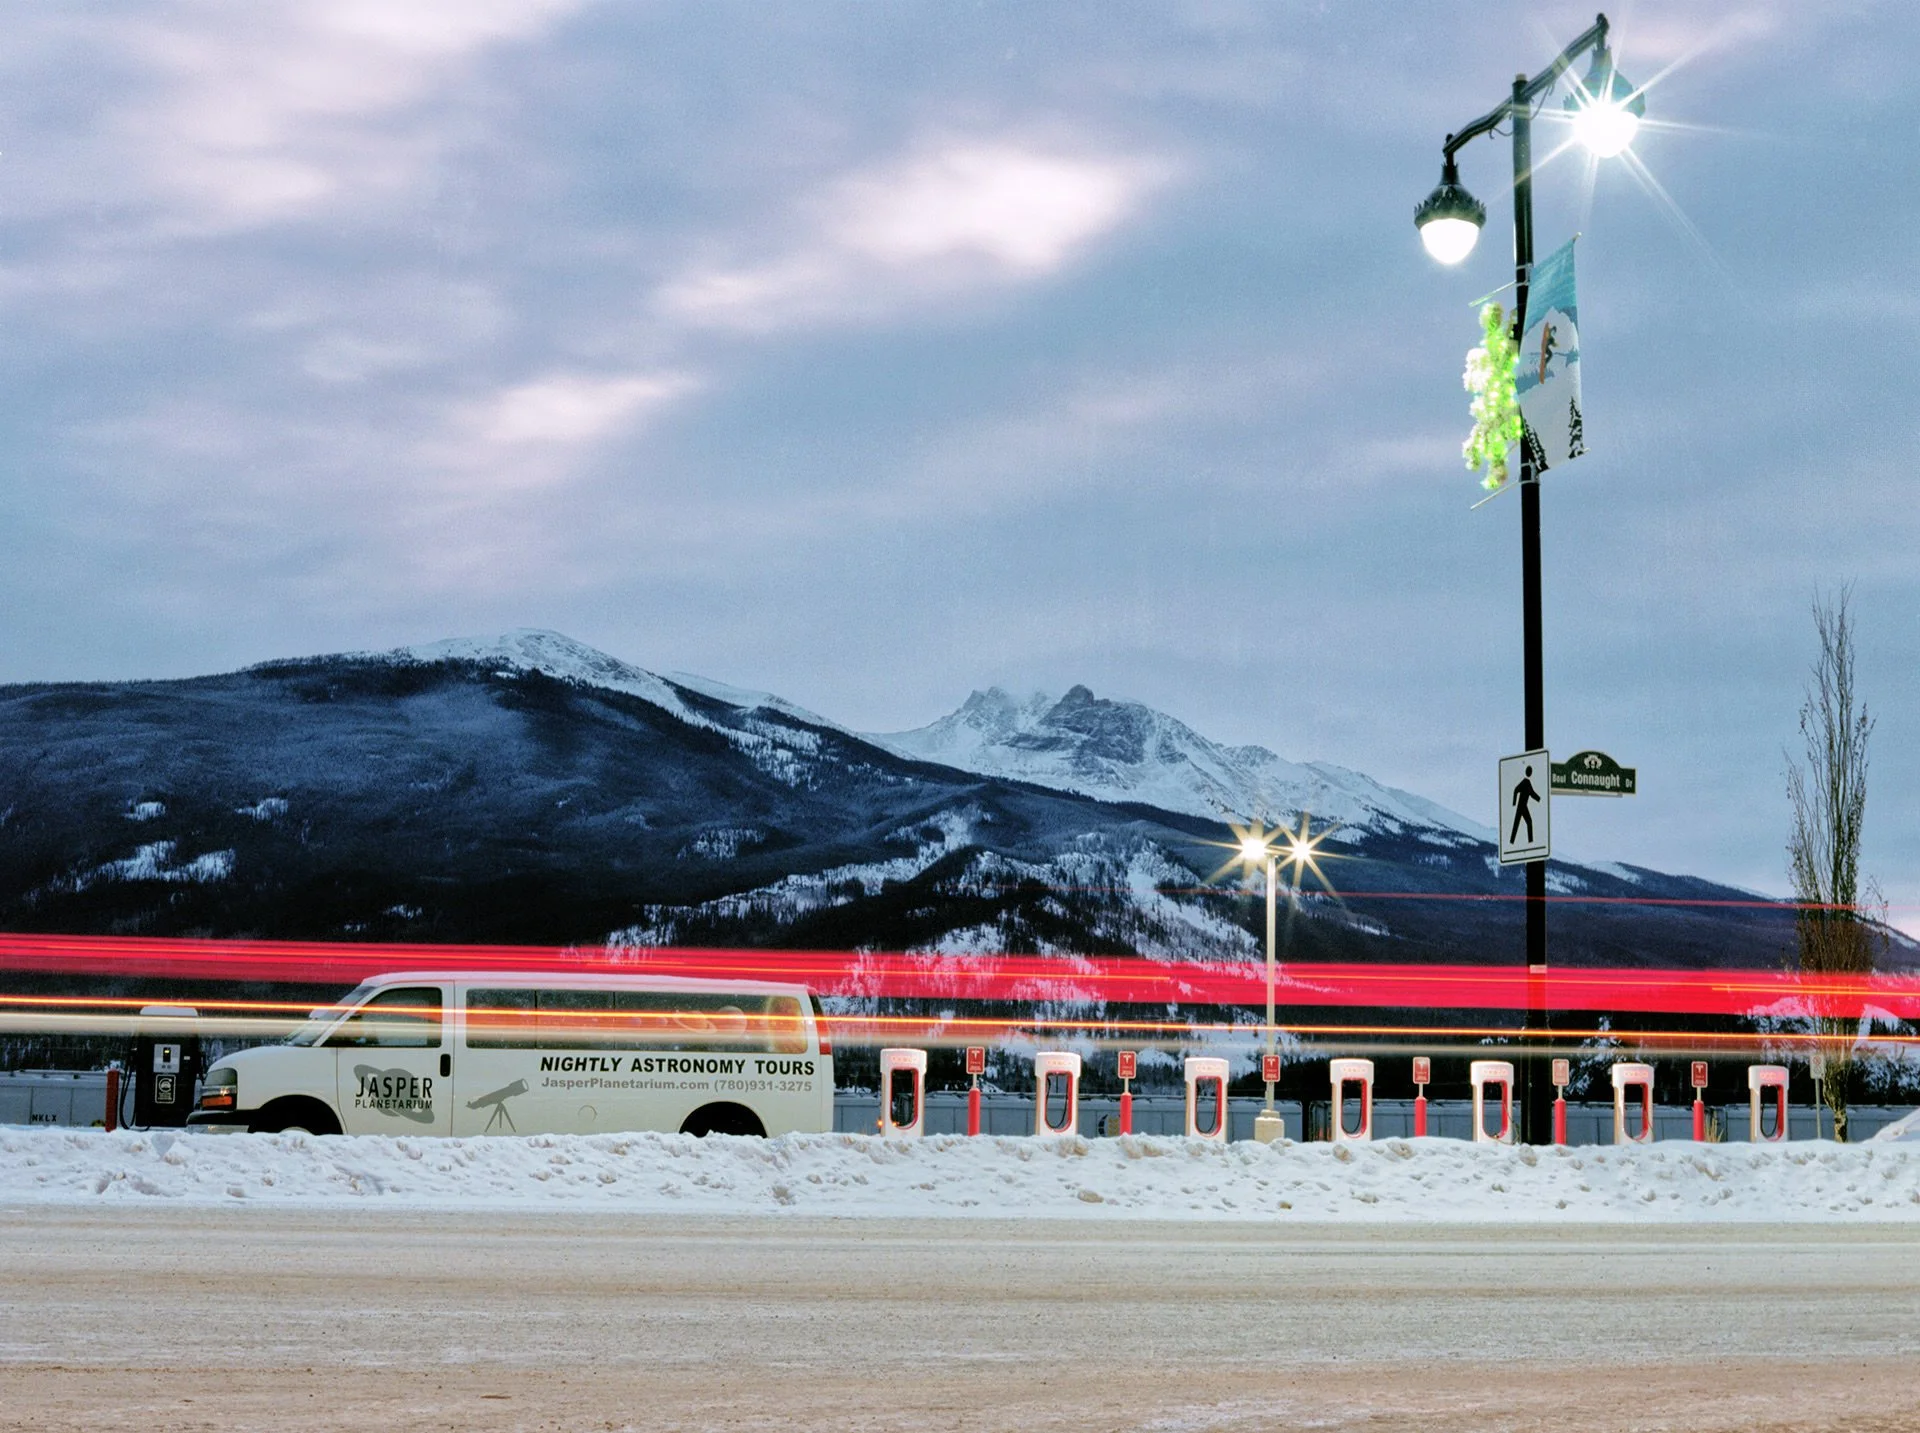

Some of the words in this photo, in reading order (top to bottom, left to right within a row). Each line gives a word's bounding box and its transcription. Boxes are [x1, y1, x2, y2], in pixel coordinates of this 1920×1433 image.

[1571, 771, 1620, 789] Connaught
[1625, 779, 1632, 788] Dr
[540, 1056, 623, 1072] NIGHTLY
[631, 1058, 746, 1074] ASTRONOMY
[755, 1060, 815, 1075] TOURS
[355, 1076, 433, 1098] JASPER
[541, 1077, 709, 1090] JasperPlanetarium.com
[714, 1080, 813, 1092] (780)931-3275
[354, 1099, 433, 1109] PLANETARIUM
